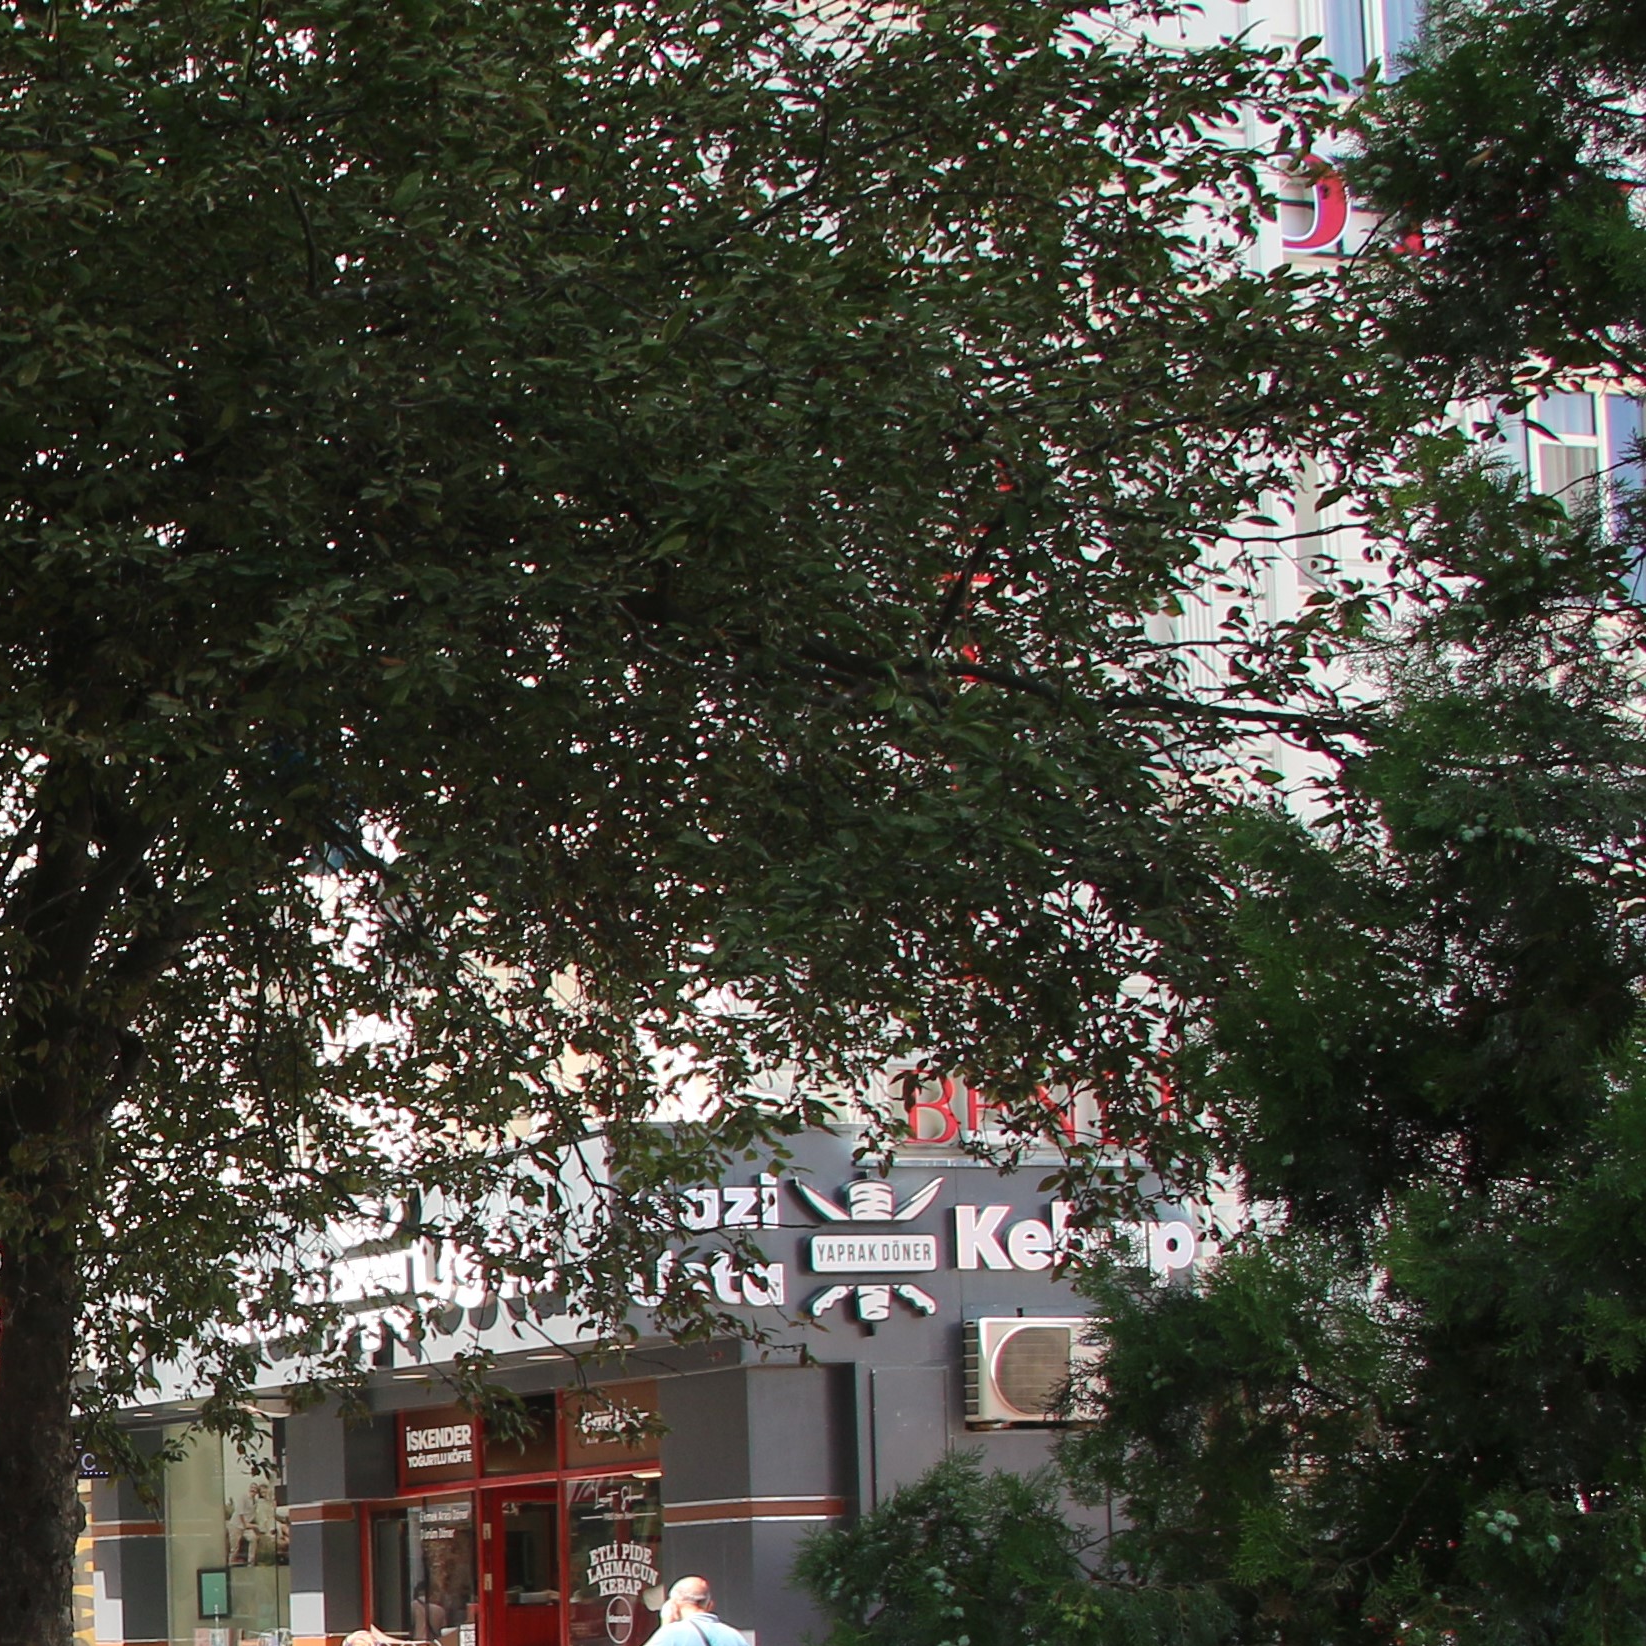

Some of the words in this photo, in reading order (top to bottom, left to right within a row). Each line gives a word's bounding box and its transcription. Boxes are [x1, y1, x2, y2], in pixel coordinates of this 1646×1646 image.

[816, 1244, 880, 1263] YAPRAK
[881, 1240, 932, 1262] DÖNER
[406, 1424, 472, 1452] İSKENDER
[407, 1453, 447, 1469] YOĞURTLU
[447, 1448, 473, 1463] KÖFTE
[589, 1540, 619, 1566] ETLİ
[621, 1540, 652, 1565] PİDE
[586, 1561, 659, 1586] LAHMACUN
[598, 1578, 642, 1597] KEBAP
